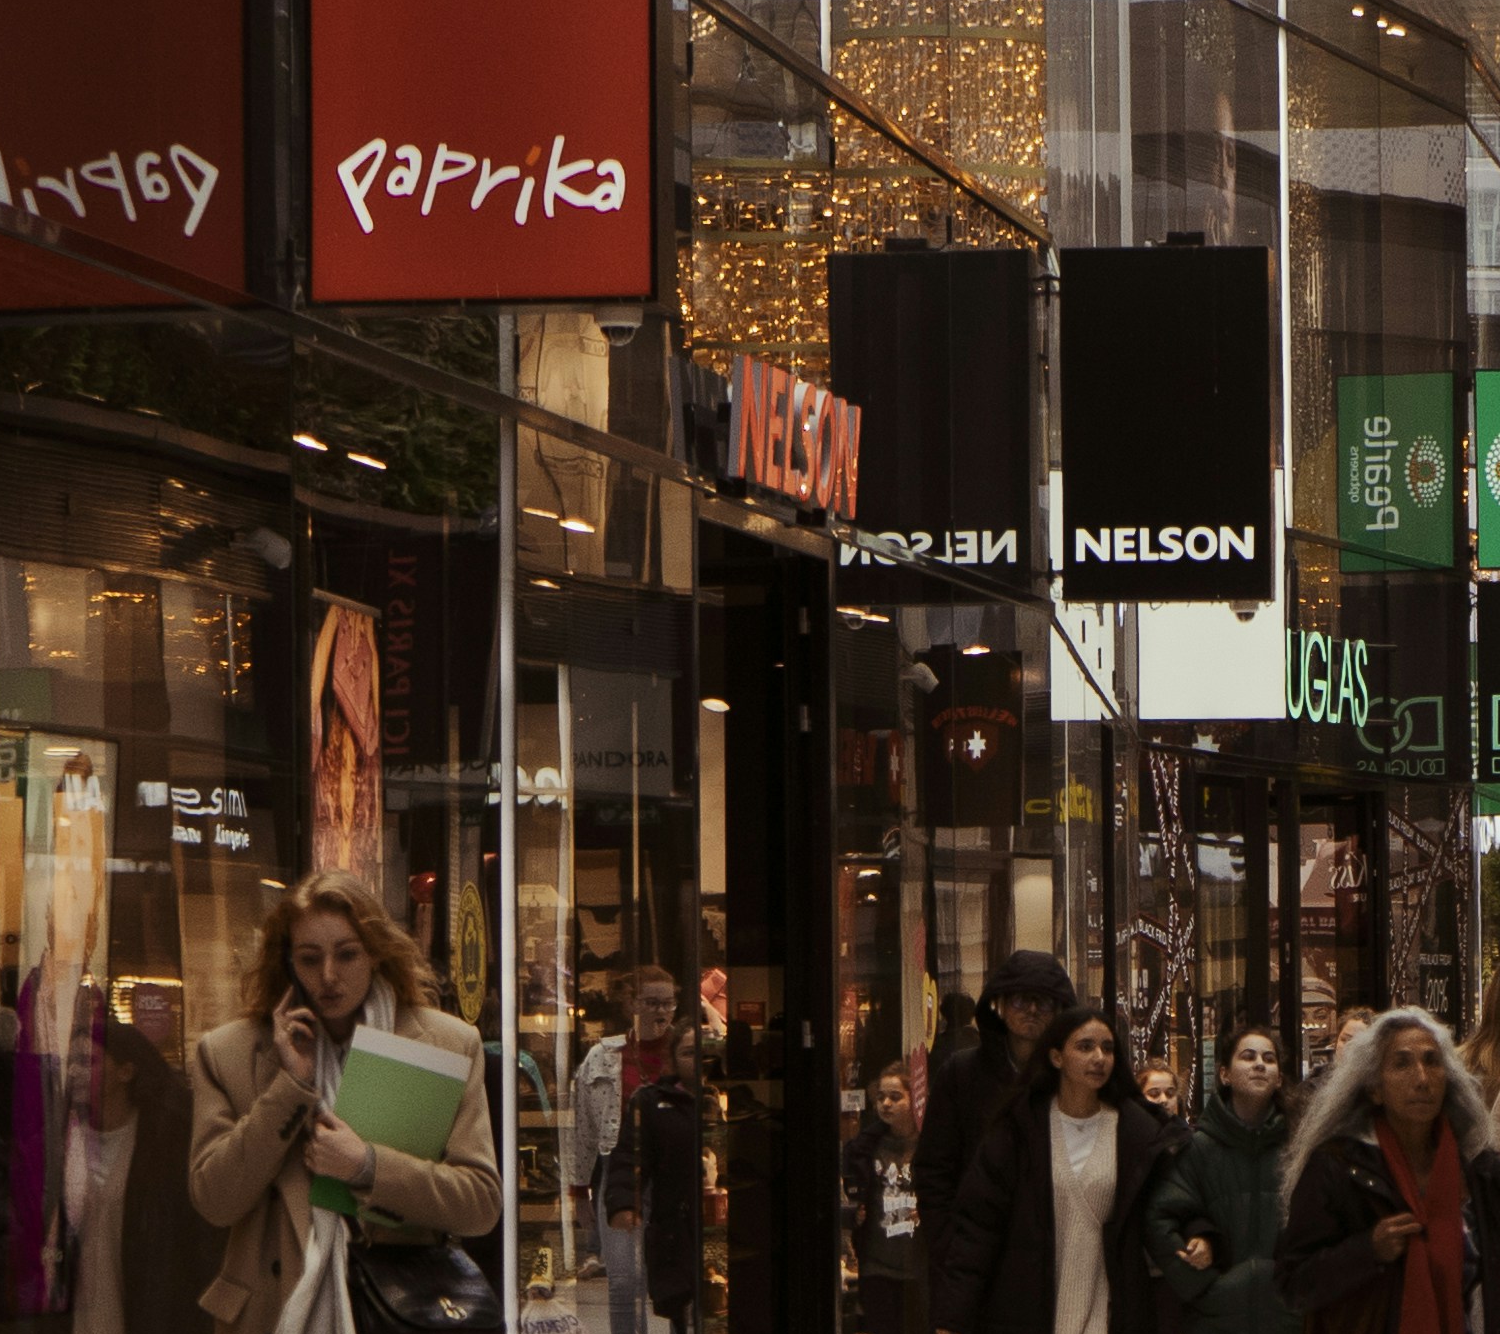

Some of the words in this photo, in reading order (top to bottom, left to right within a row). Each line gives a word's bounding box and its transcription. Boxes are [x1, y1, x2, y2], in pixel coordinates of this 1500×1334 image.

[737, 354, 861, 521] NELSON
[1074, 525, 1256, 563] NELSON
[1286, 630, 1369, 727] UGLAS
